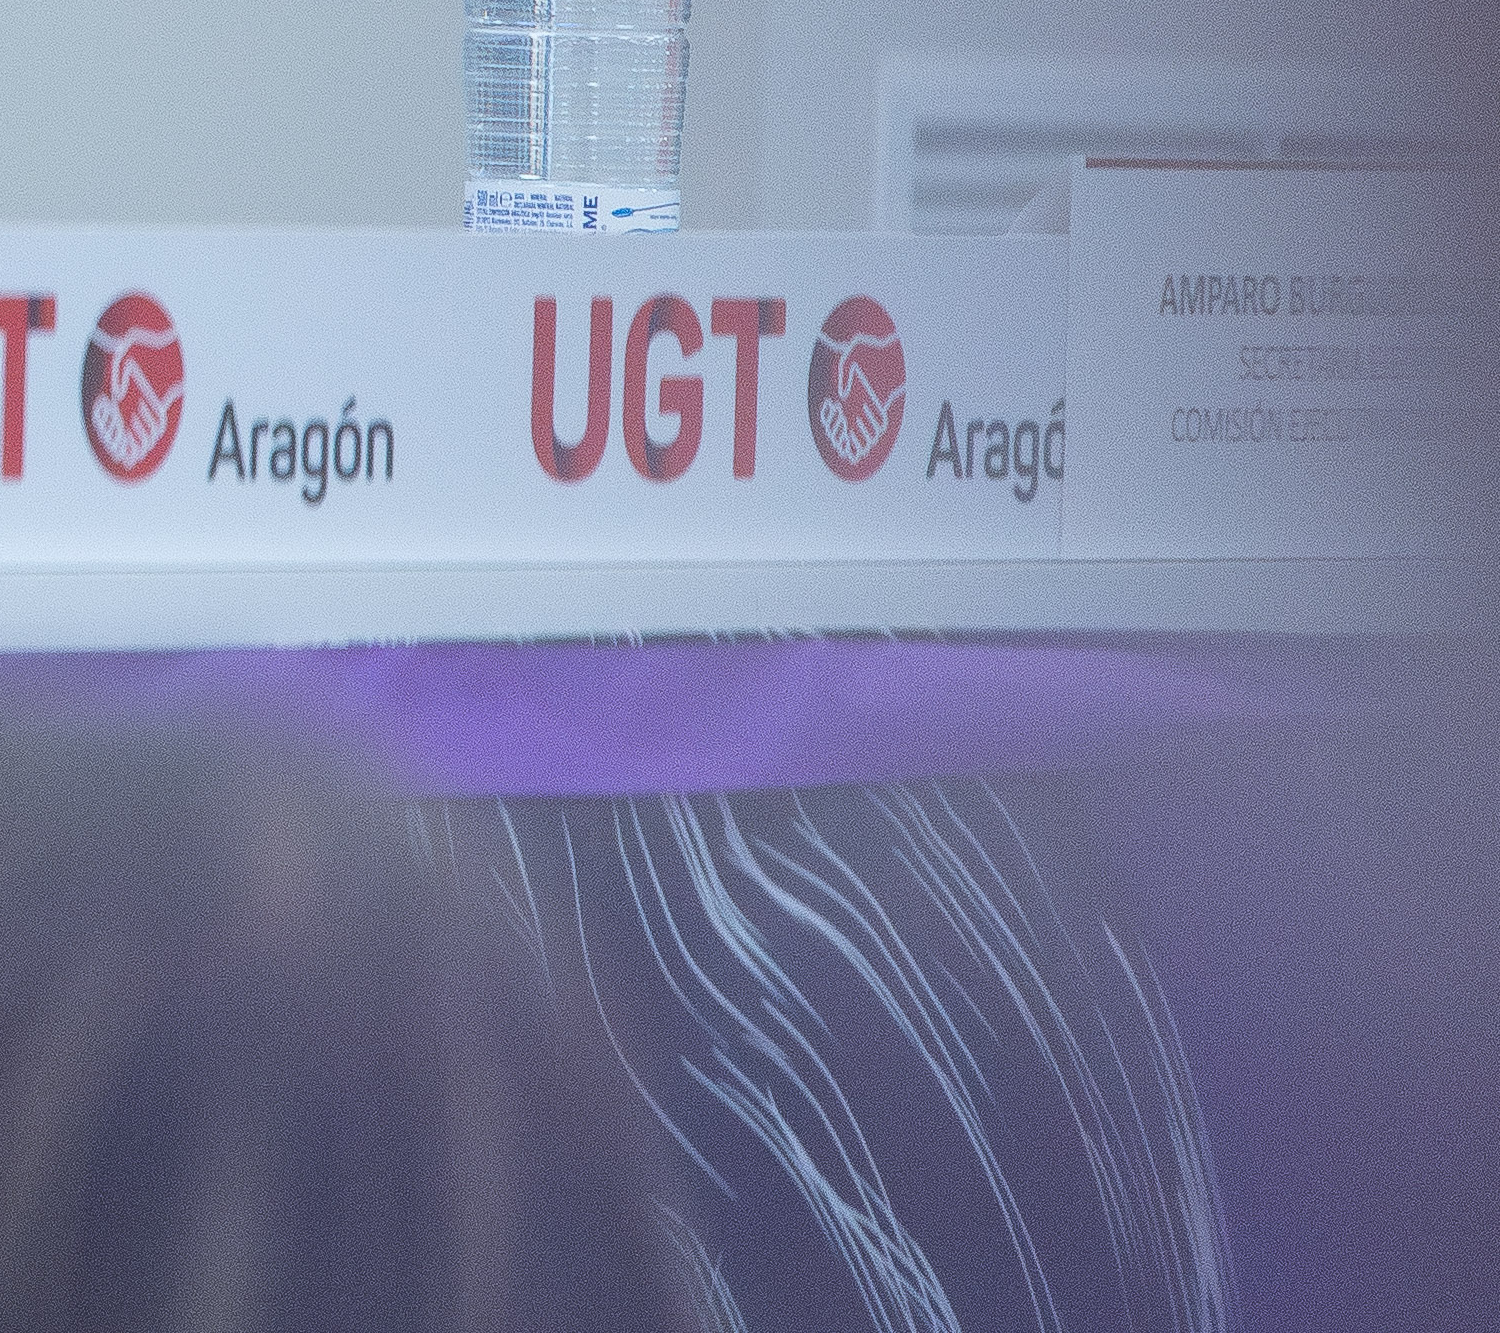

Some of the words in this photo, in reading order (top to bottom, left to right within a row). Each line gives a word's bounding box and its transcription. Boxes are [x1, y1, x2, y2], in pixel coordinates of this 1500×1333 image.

[582, 195, 598, 234] ME
[1158, 273, 1282, 316] AMPARO
[530, 293, 787, 484] UGT
[925, 398, 1066, 504] Aragó
[1170, 399, 1283, 442] COMISIÓN
[207, 396, 396, 507] Aragón
